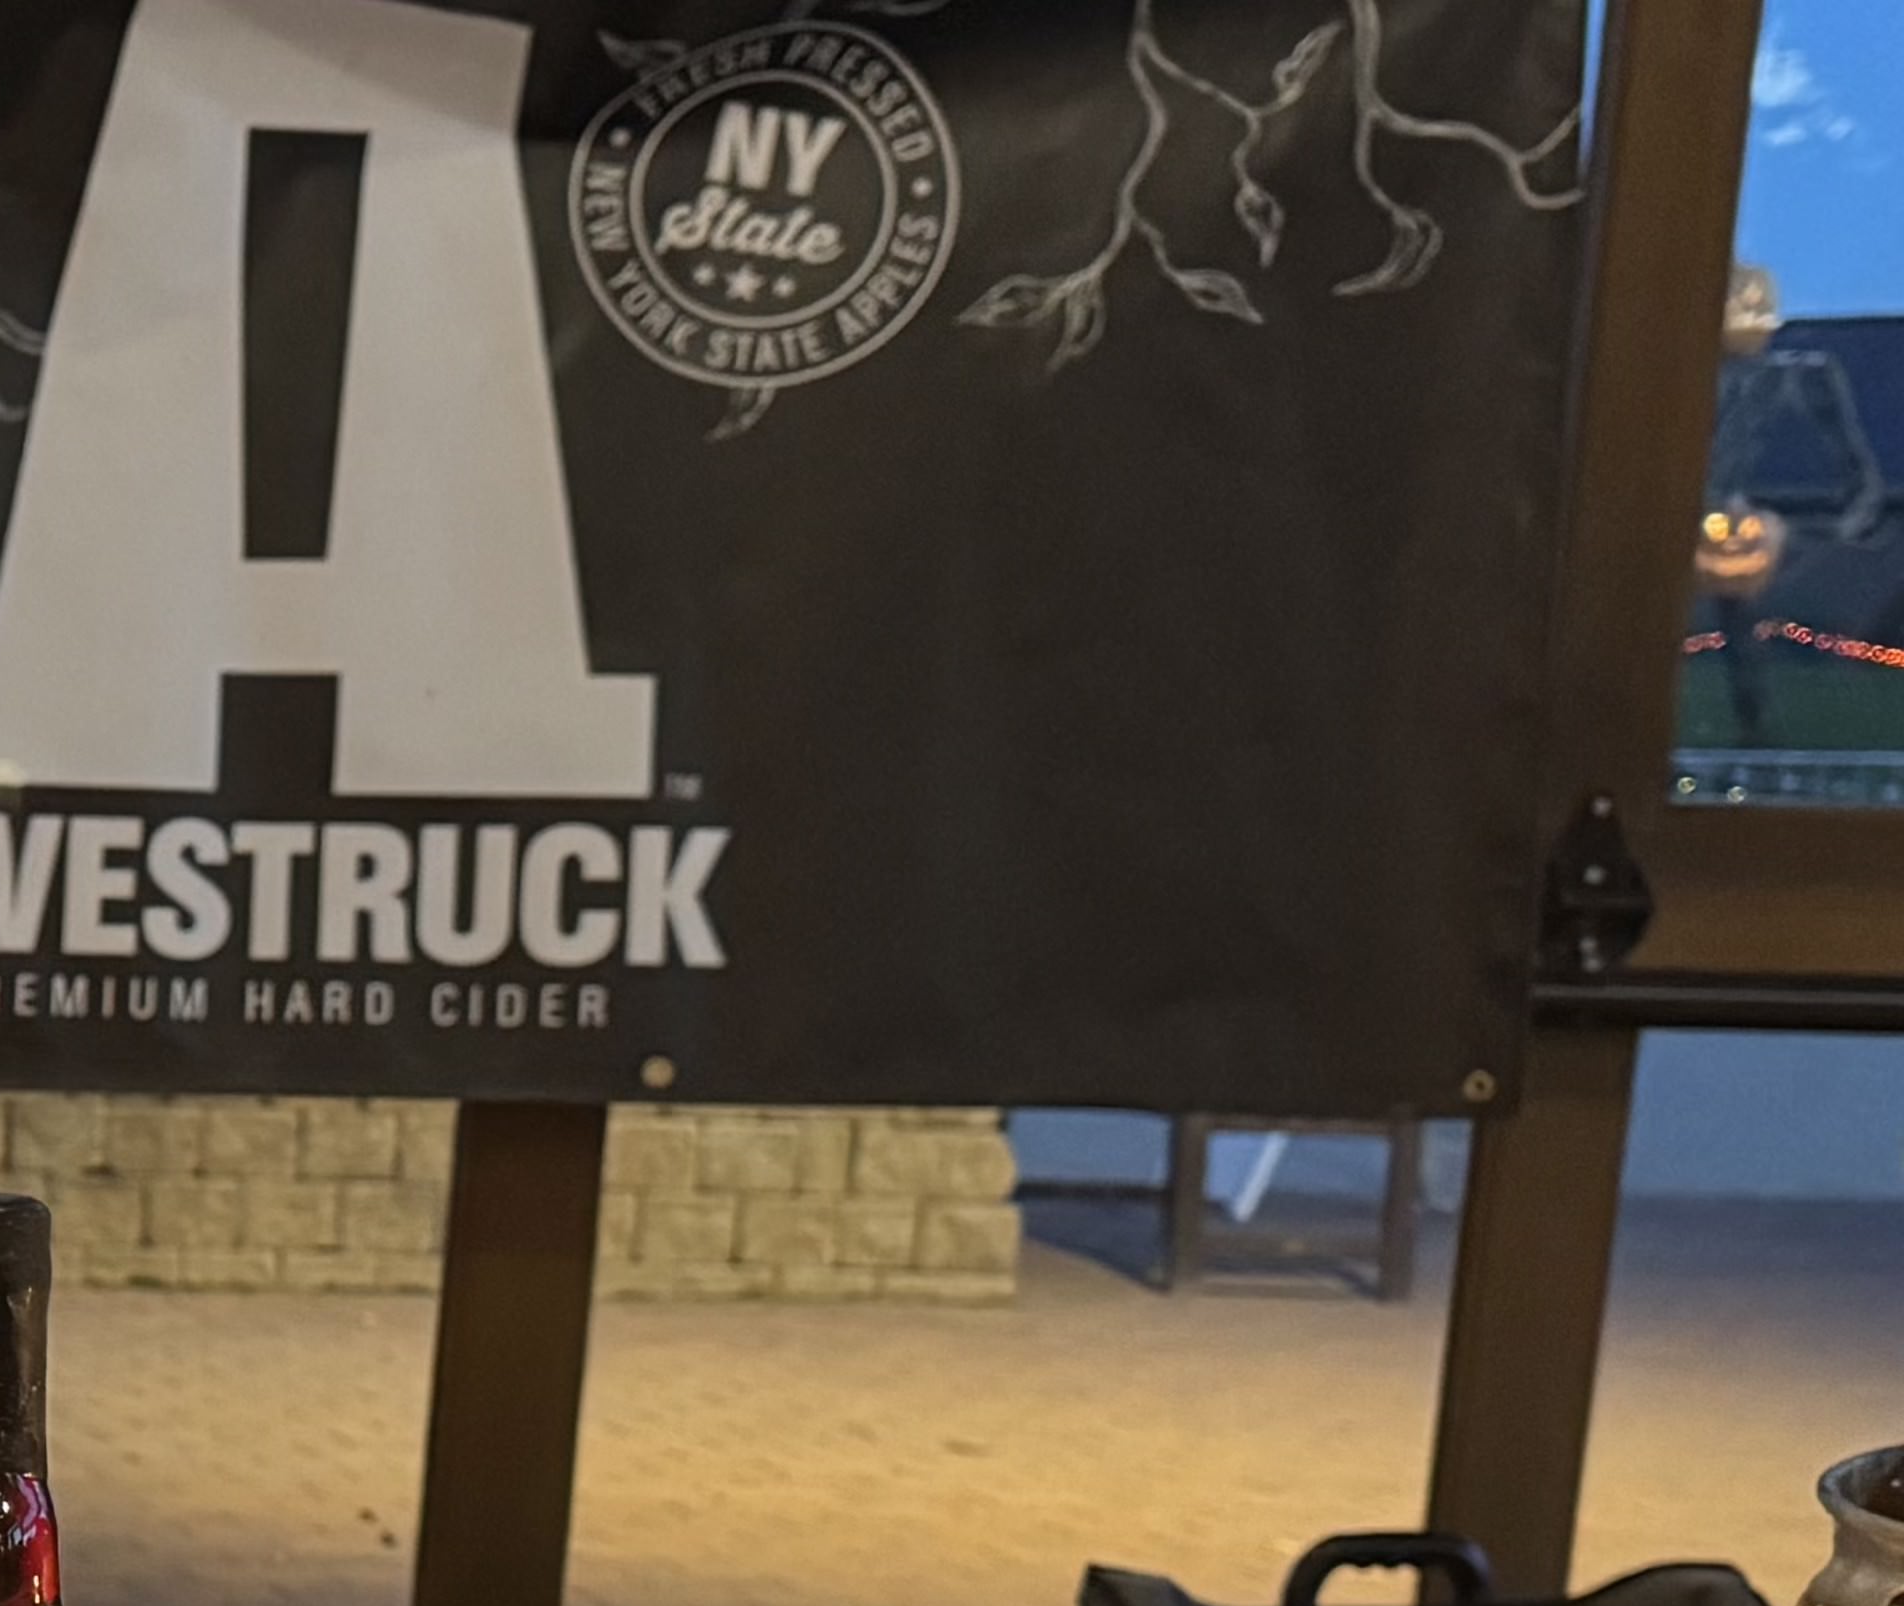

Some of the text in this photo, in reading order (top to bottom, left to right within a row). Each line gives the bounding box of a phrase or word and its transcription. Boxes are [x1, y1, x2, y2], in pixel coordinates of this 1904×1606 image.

[633, 34, 934, 161] FRESH PRESSED
[705, 101, 848, 196] NY
[584, 162, 938, 370] NEW YORK STATE APPLES
[656, 184, 845, 264] State
[246, 982, 394, 1023] HARD
[430, 987, 609, 1028] CIDER
